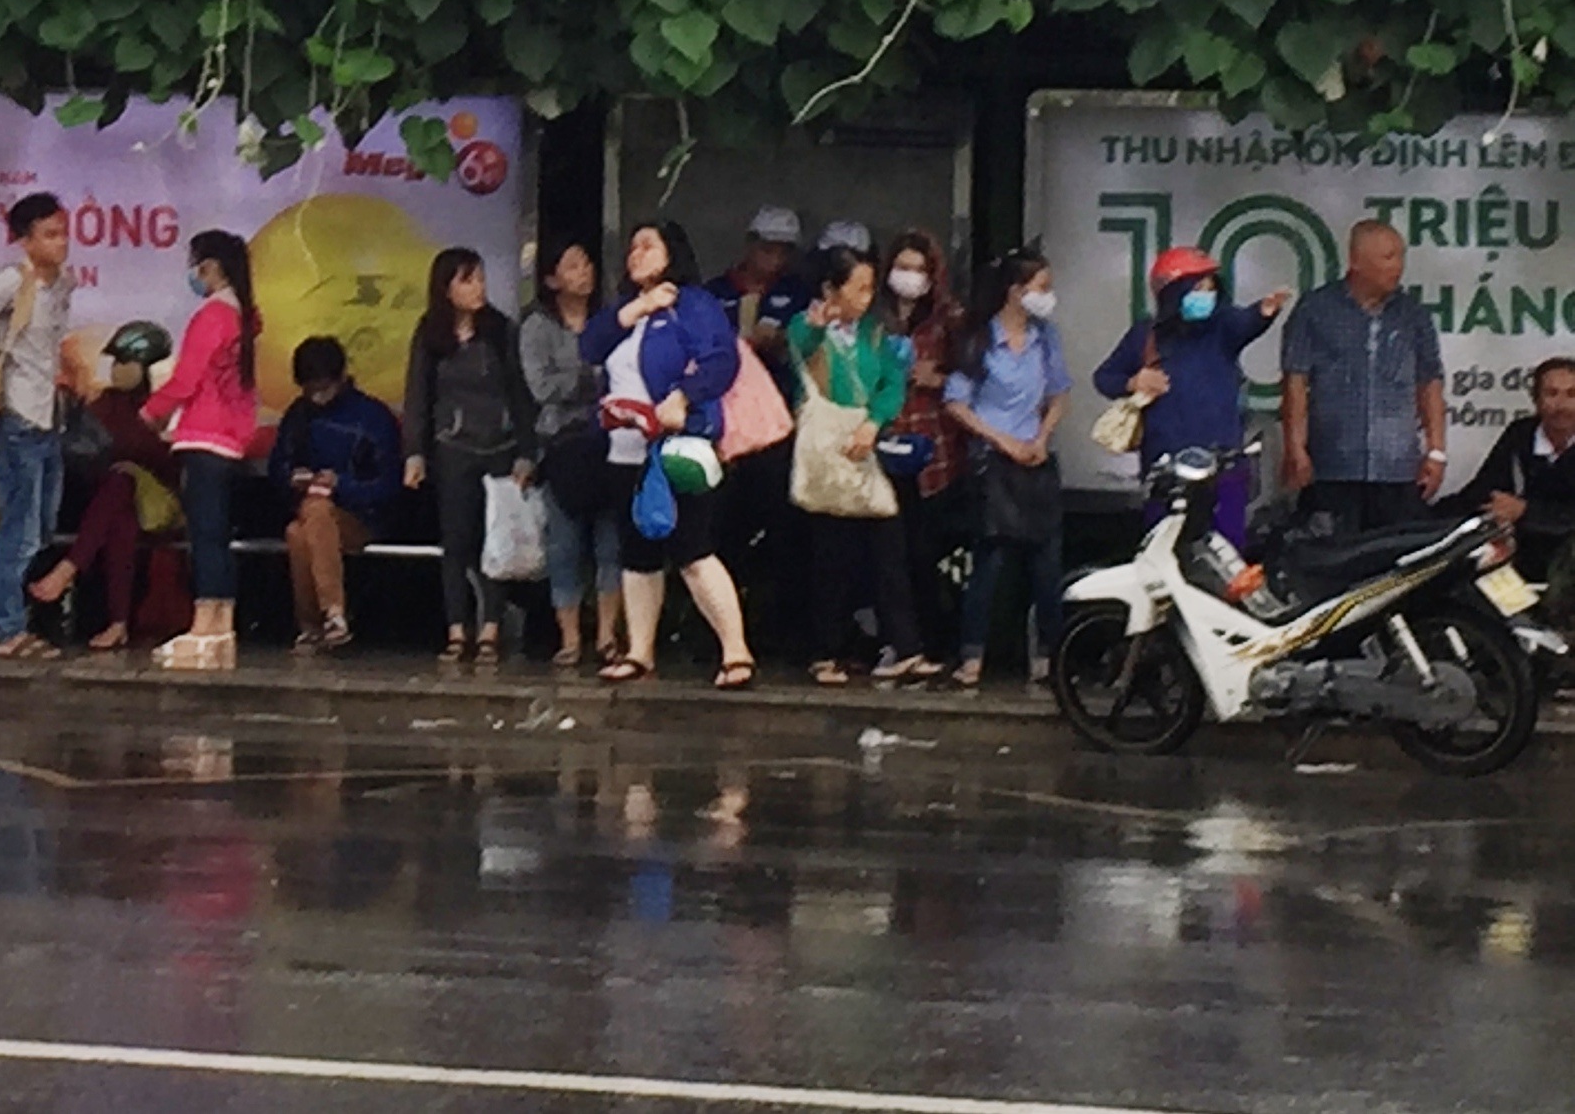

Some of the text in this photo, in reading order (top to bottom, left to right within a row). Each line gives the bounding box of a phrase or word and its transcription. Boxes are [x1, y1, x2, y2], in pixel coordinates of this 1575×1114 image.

[1102, 136, 1176, 163] THU
[1186, 129, 1289, 172] NHẬP
[1479, 134, 1546, 168] LÊN
[63, 186, 180, 248] ỒNG
[1364, 183, 1560, 262] TRIỆU
